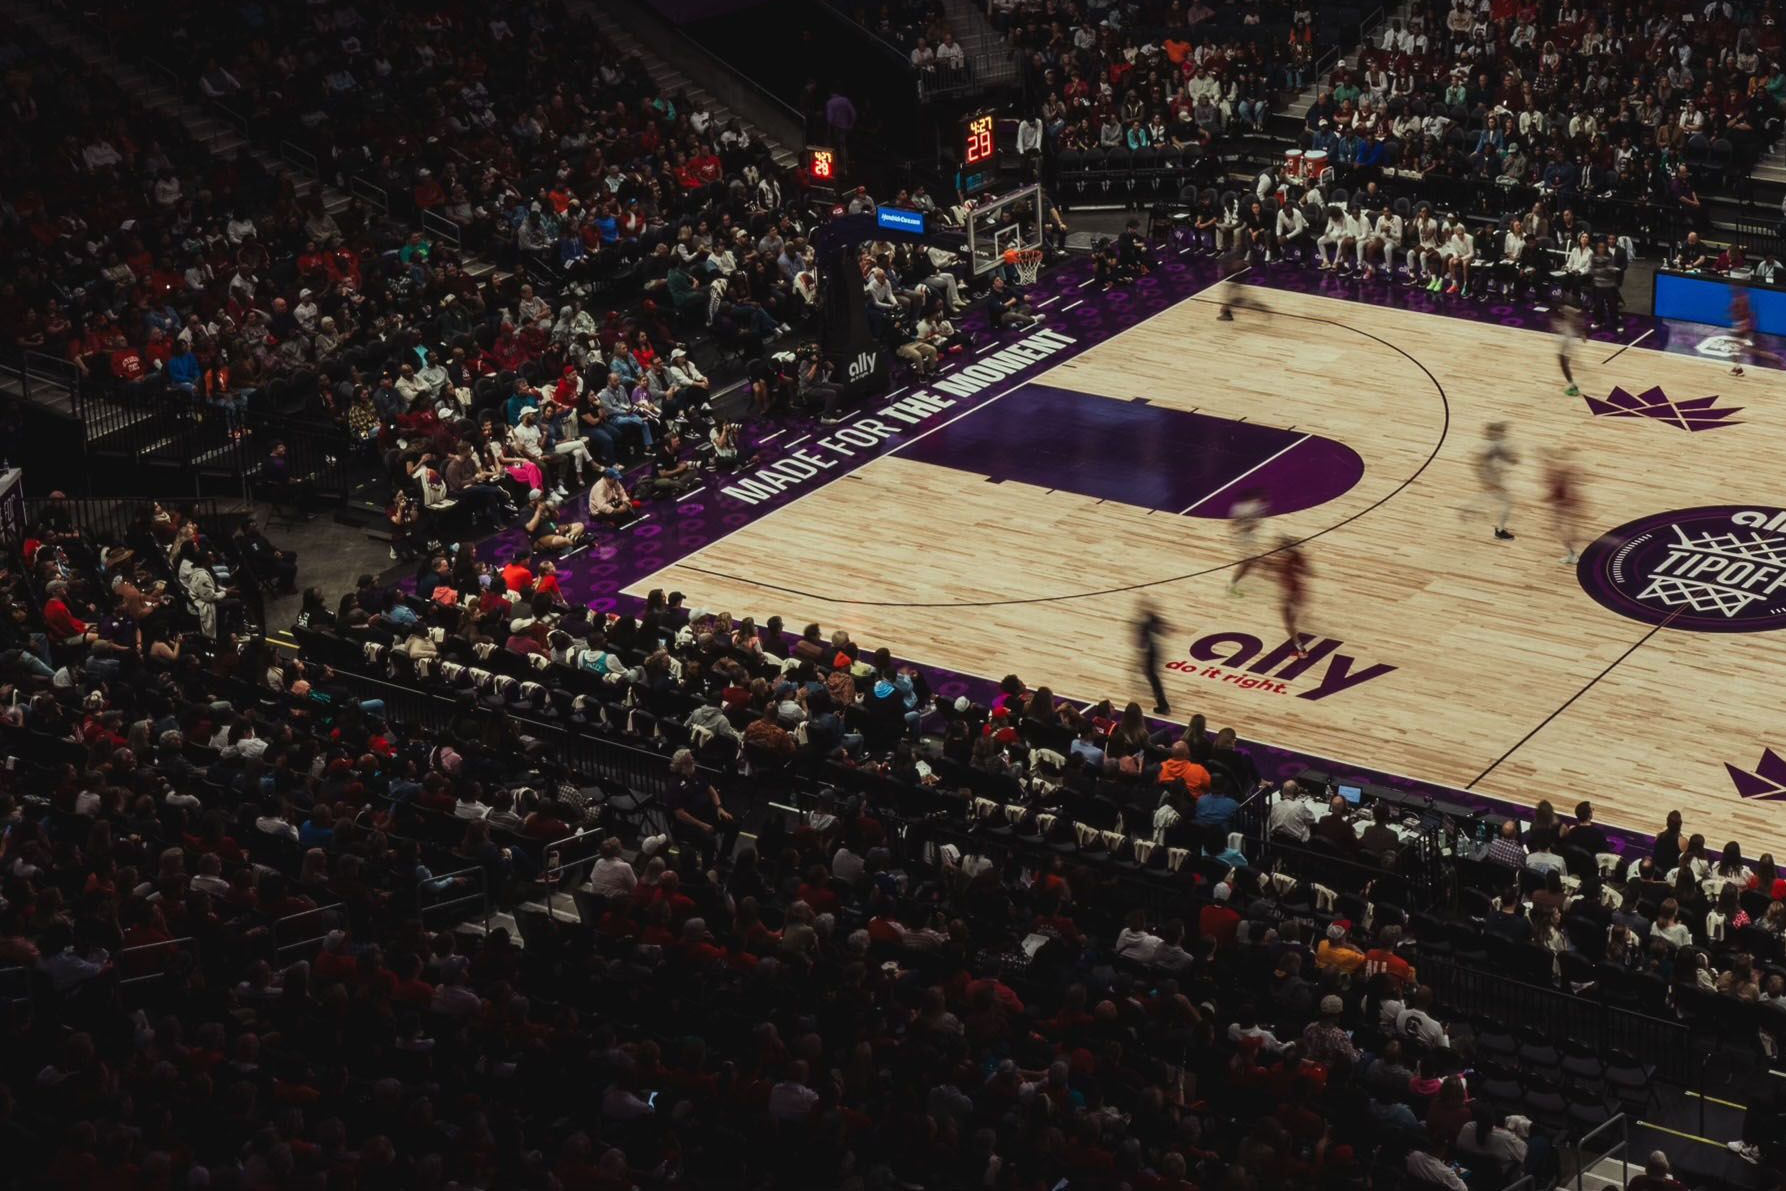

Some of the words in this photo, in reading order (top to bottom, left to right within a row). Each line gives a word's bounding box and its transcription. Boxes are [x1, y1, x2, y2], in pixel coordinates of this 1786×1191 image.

[970, 115, 992, 134] 4:27
[814, 151, 832, 163] 4:27
[815, 162, 829, 176] 28
[849, 352, 877, 377] ally
[720, 447, 839, 505] MADE
[817, 418, 902, 456] FOR
[877, 389, 957, 424] THE
[931, 328, 1078, 398] MOMENT
[1165, 660, 1197, 673] do
[1200, 666, 1222, 679] it
[1222, 674, 1288, 695] right.
[1189, 631, 1399, 701] ally
